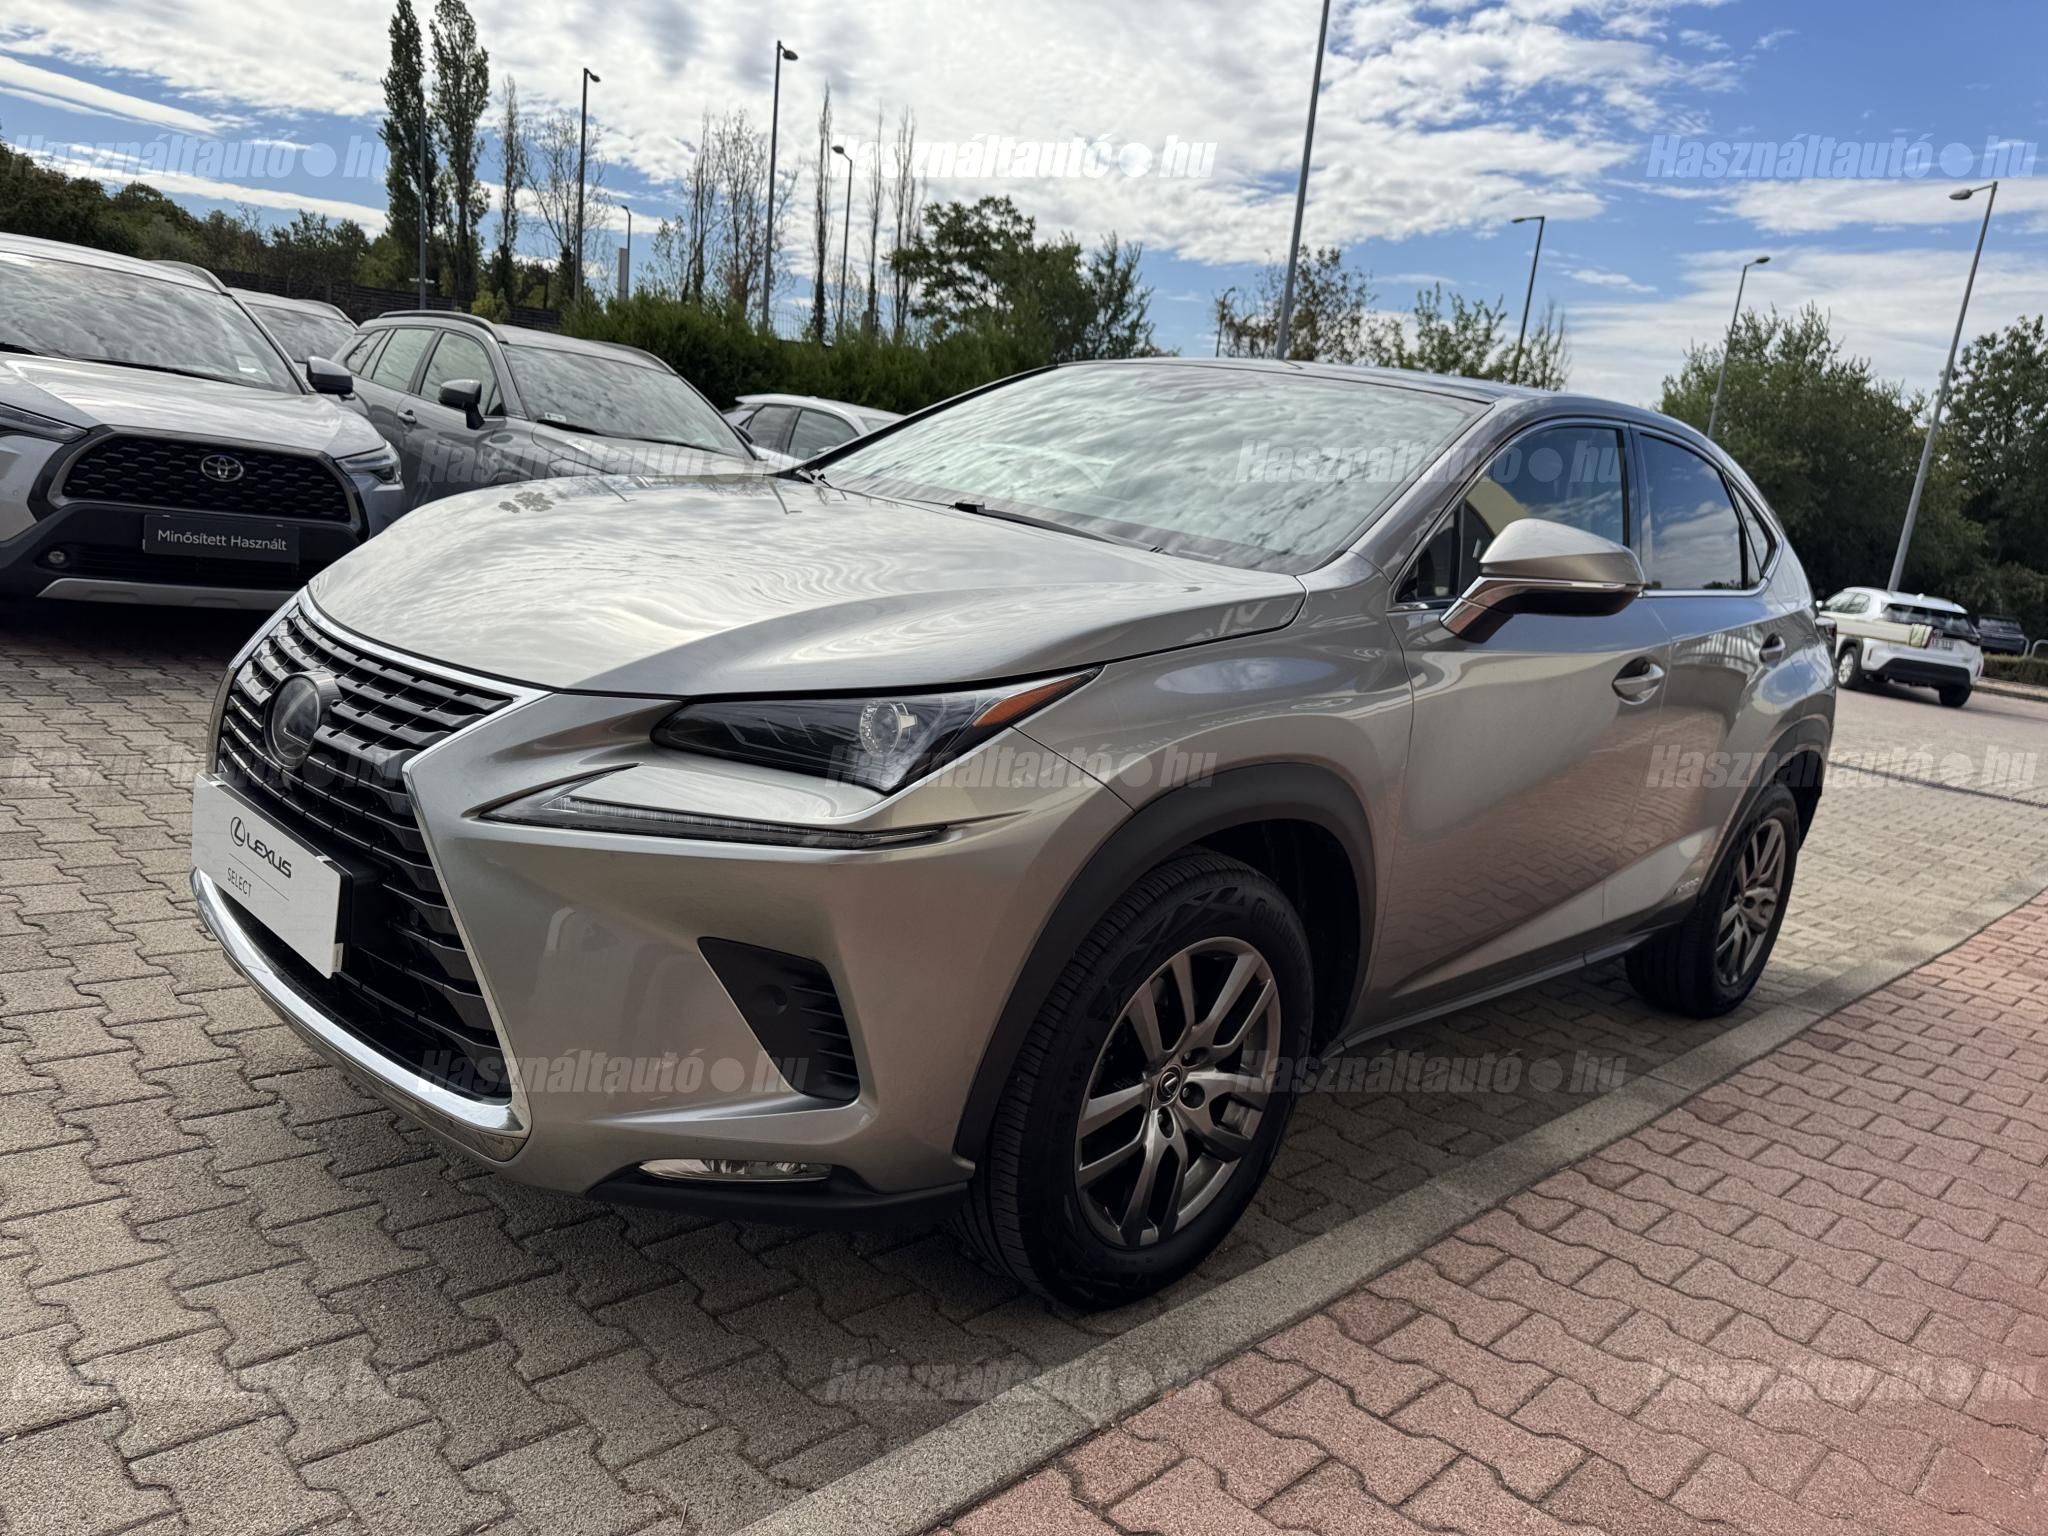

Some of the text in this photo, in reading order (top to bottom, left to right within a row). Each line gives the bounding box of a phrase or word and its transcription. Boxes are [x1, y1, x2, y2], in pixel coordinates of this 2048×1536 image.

[157, 529, 288, 551] Minősített Használt
[246, 832, 292, 879] LEXUS
[227, 867, 252, 897] SELECT
